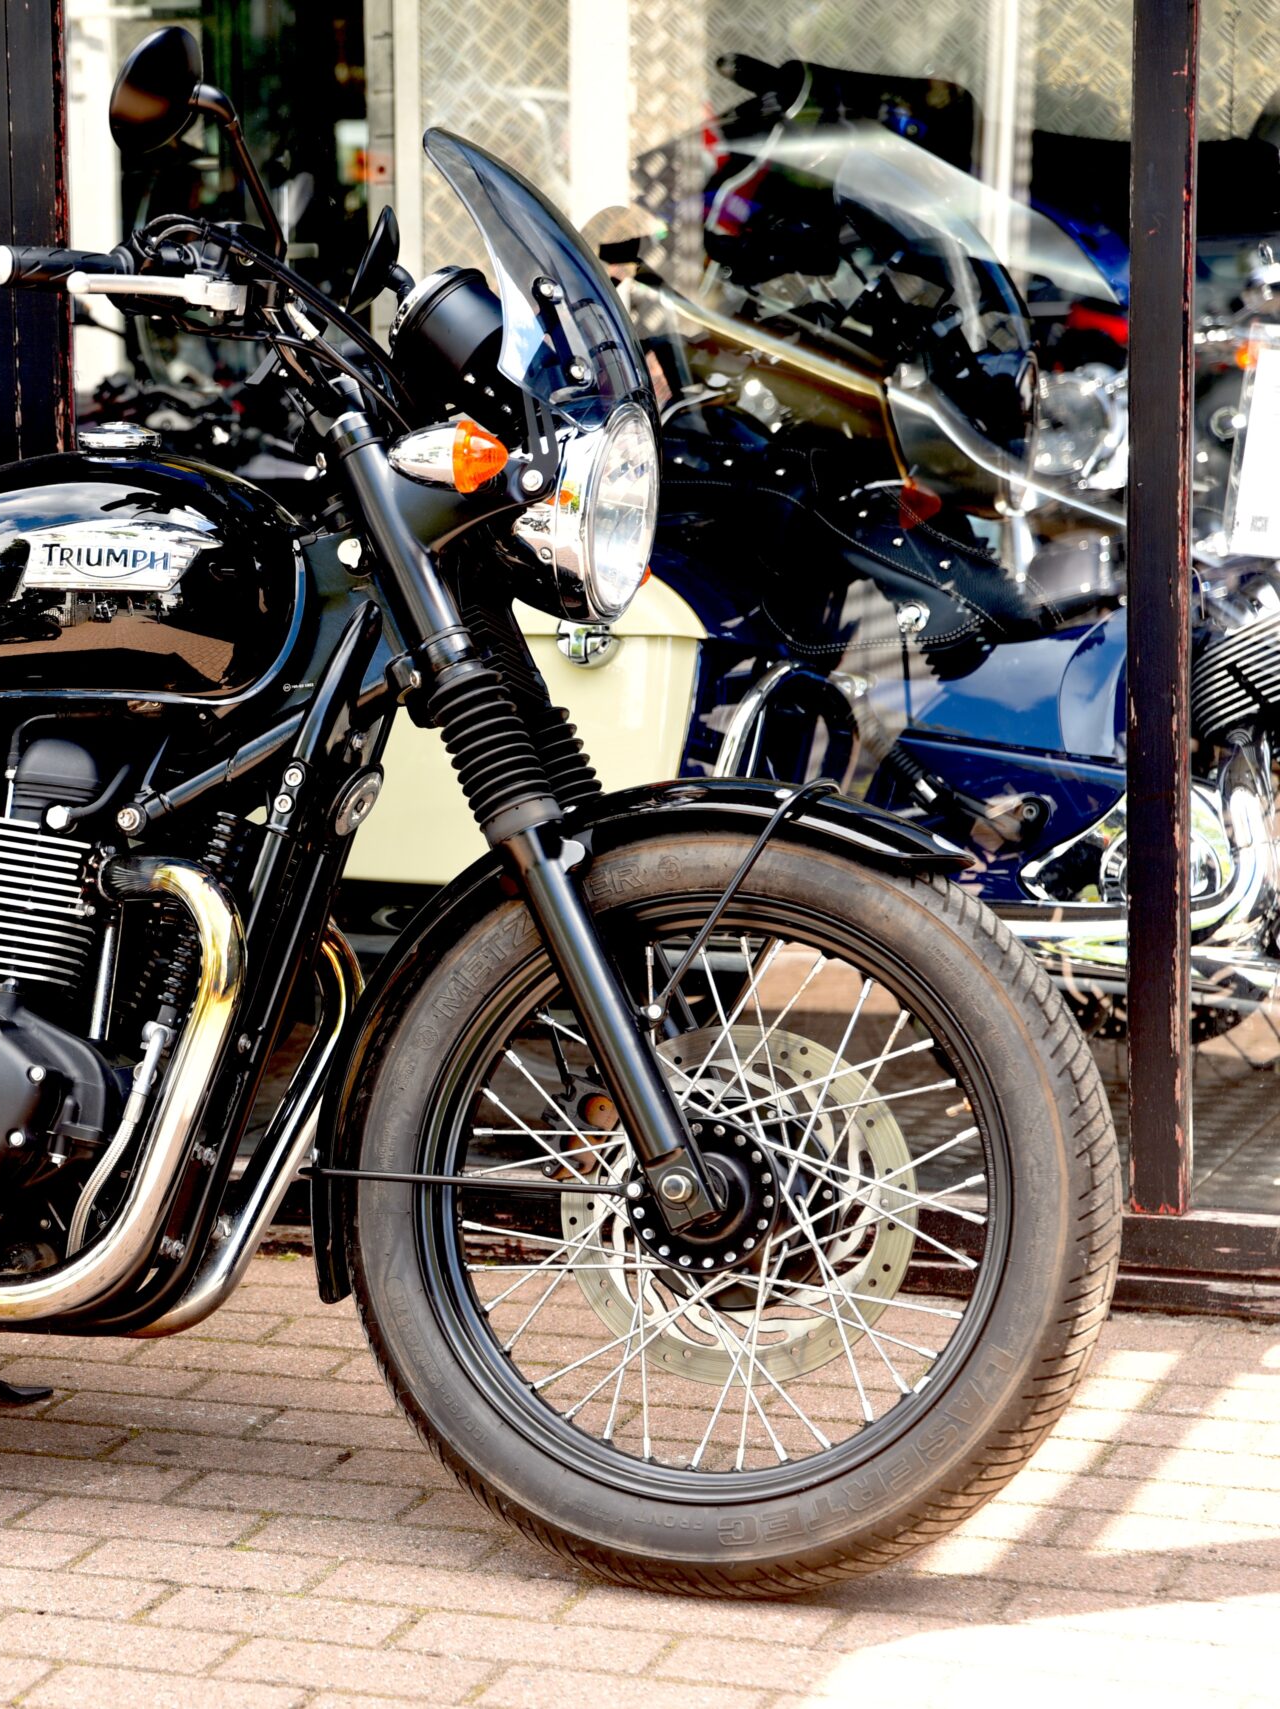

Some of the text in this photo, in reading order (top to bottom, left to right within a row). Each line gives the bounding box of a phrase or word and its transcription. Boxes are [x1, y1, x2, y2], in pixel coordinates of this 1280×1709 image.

[41, 543, 169, 578] TRIUMPH
[433, 863, 644, 1019] METZER
[717, 1343, 1018, 1546] LASERTEC
